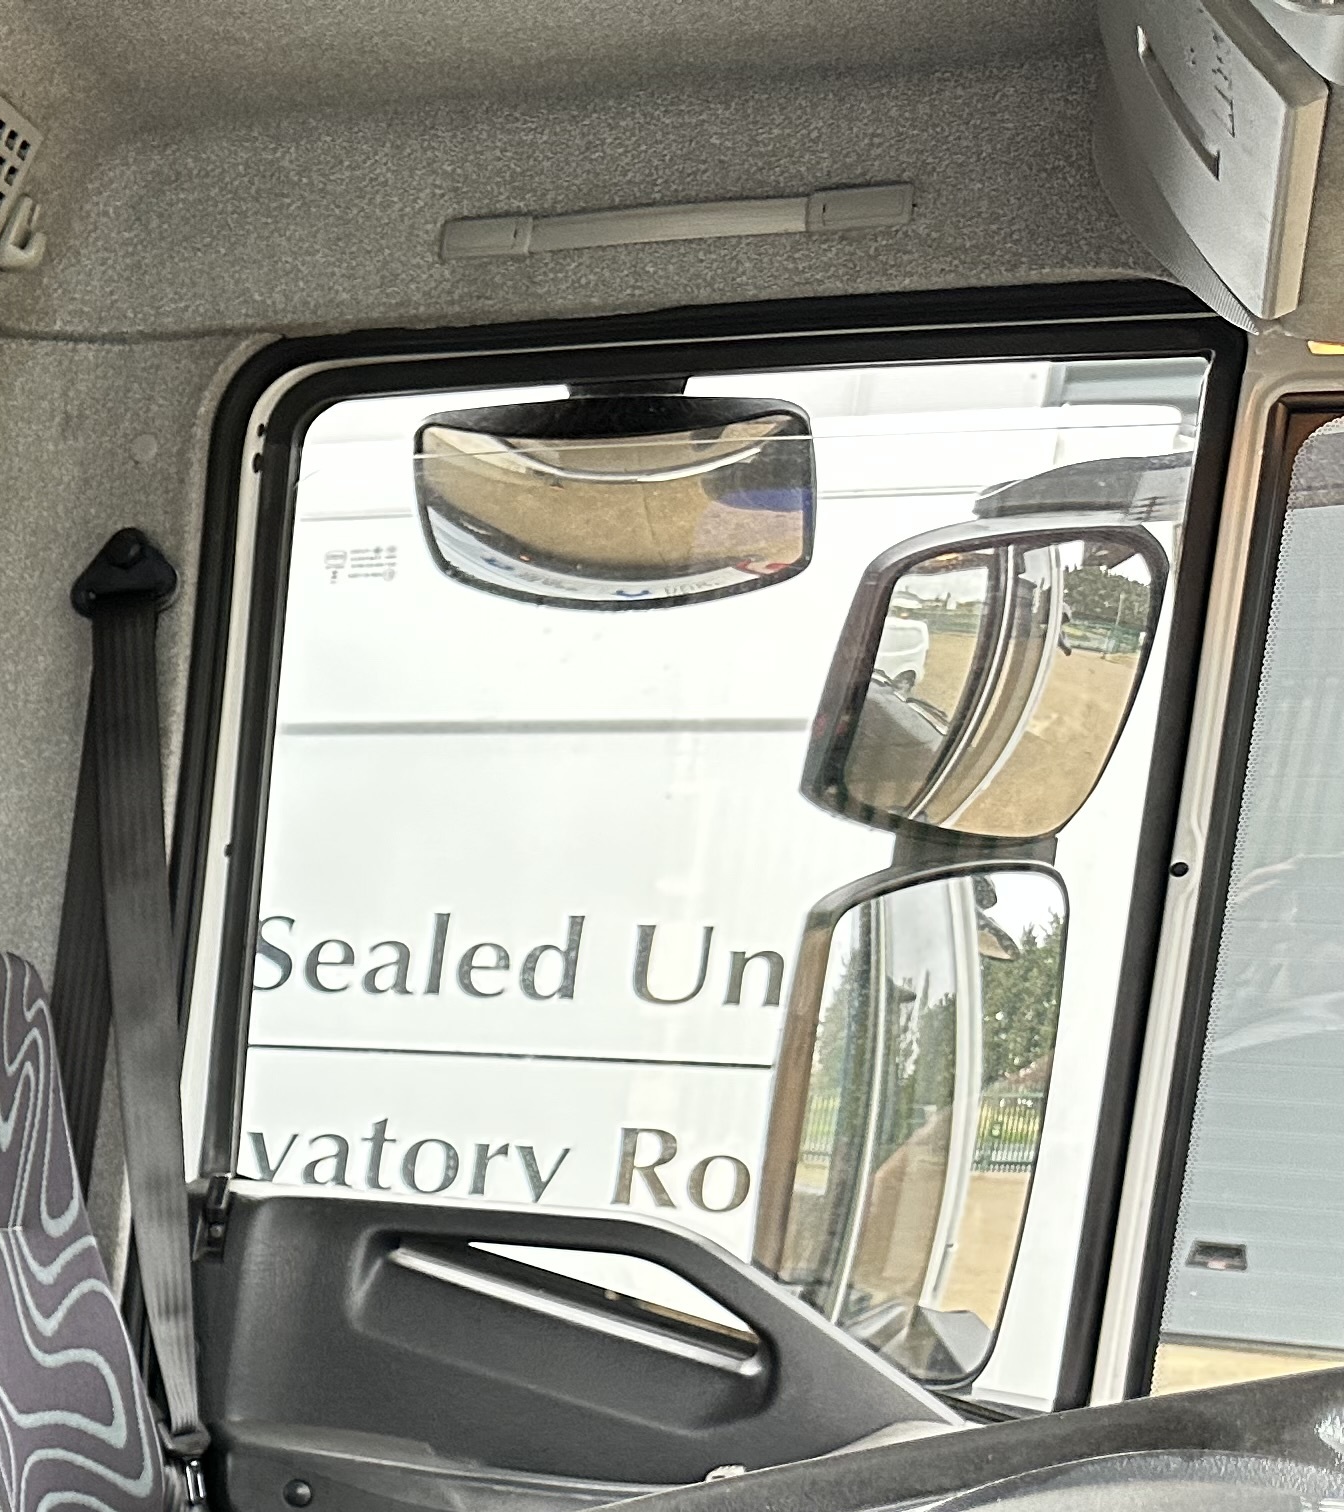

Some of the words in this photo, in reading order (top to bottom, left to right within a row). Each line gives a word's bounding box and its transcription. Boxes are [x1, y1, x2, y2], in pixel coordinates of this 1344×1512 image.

[252, 912, 586, 1000] Sealed
[632, 924, 785, 1007] Un
[610, 1127, 751, 1213] Ro
